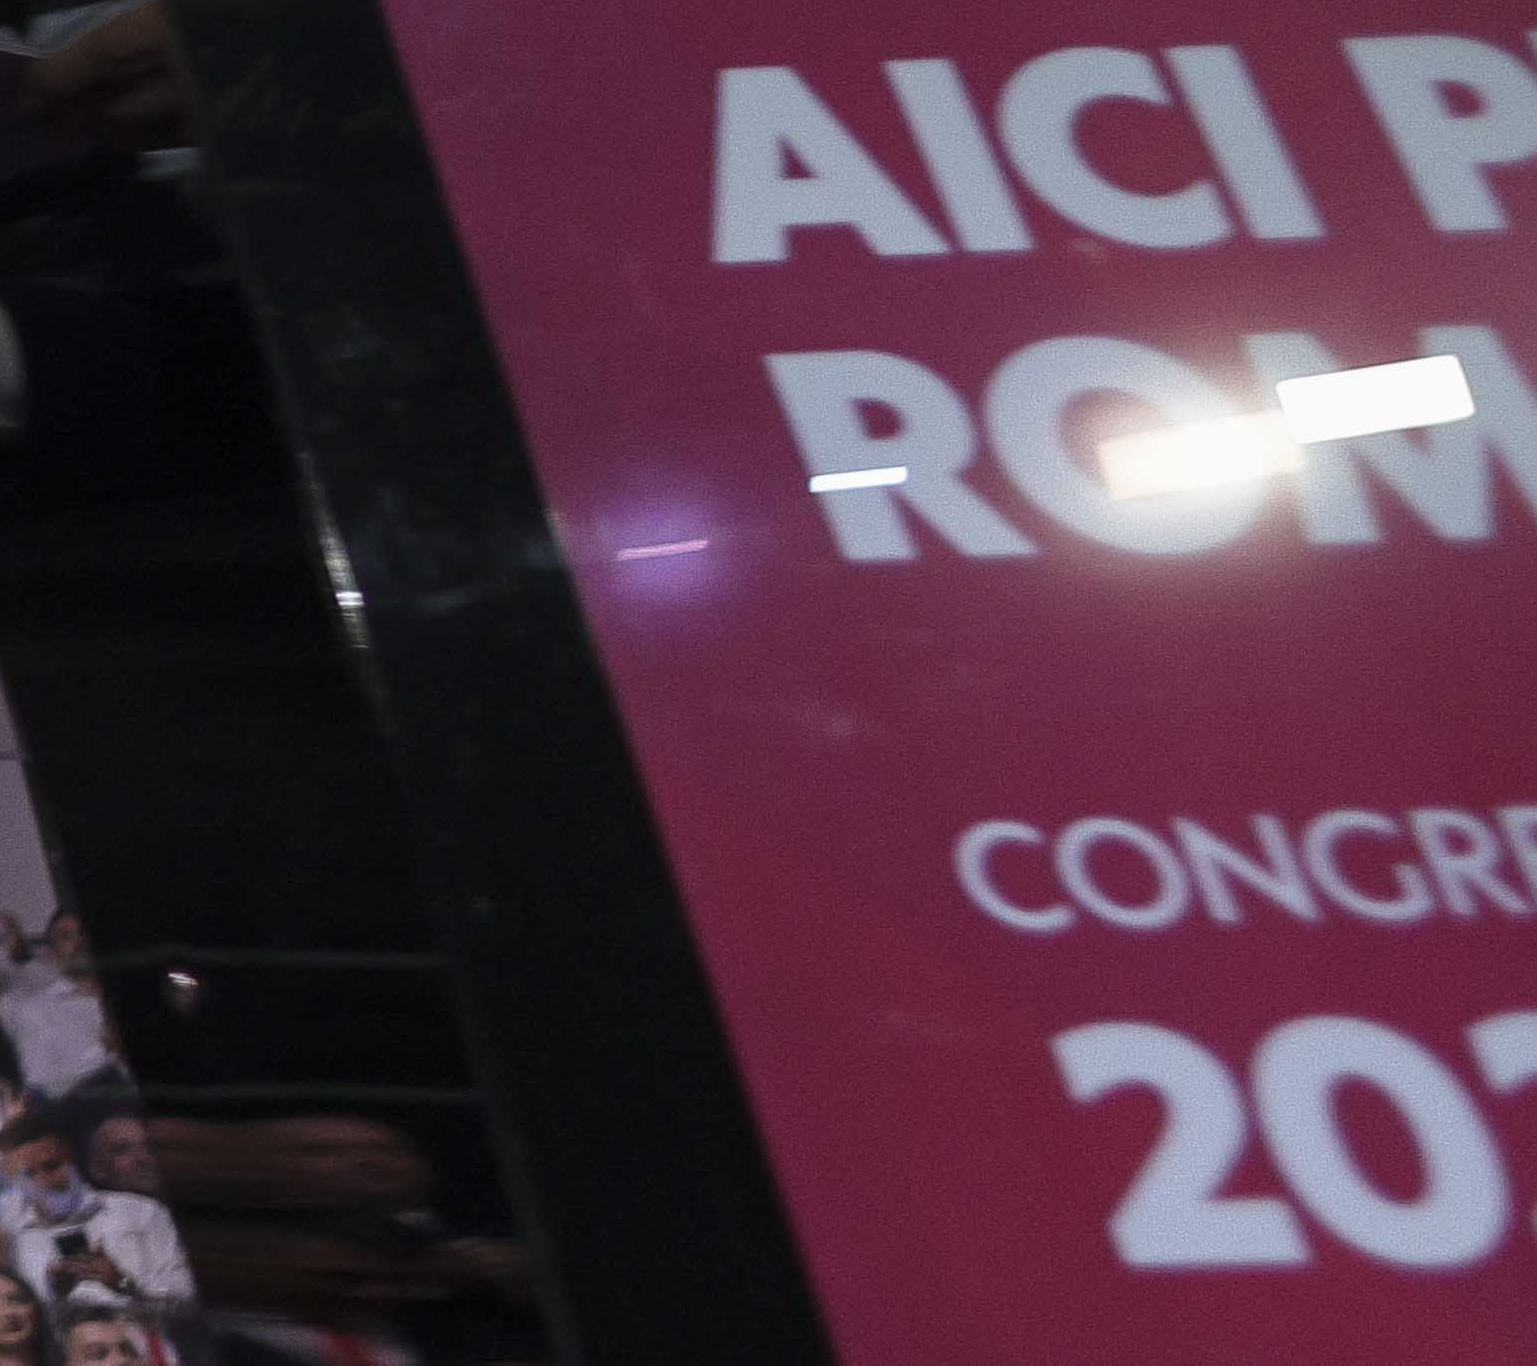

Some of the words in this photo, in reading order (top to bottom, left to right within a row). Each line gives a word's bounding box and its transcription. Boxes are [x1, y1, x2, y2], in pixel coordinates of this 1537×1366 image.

[711, 45, 1327, 263] AICI
[1341, 31, 1537, 233] P
[1047, 1013, 1537, 1269] 20
